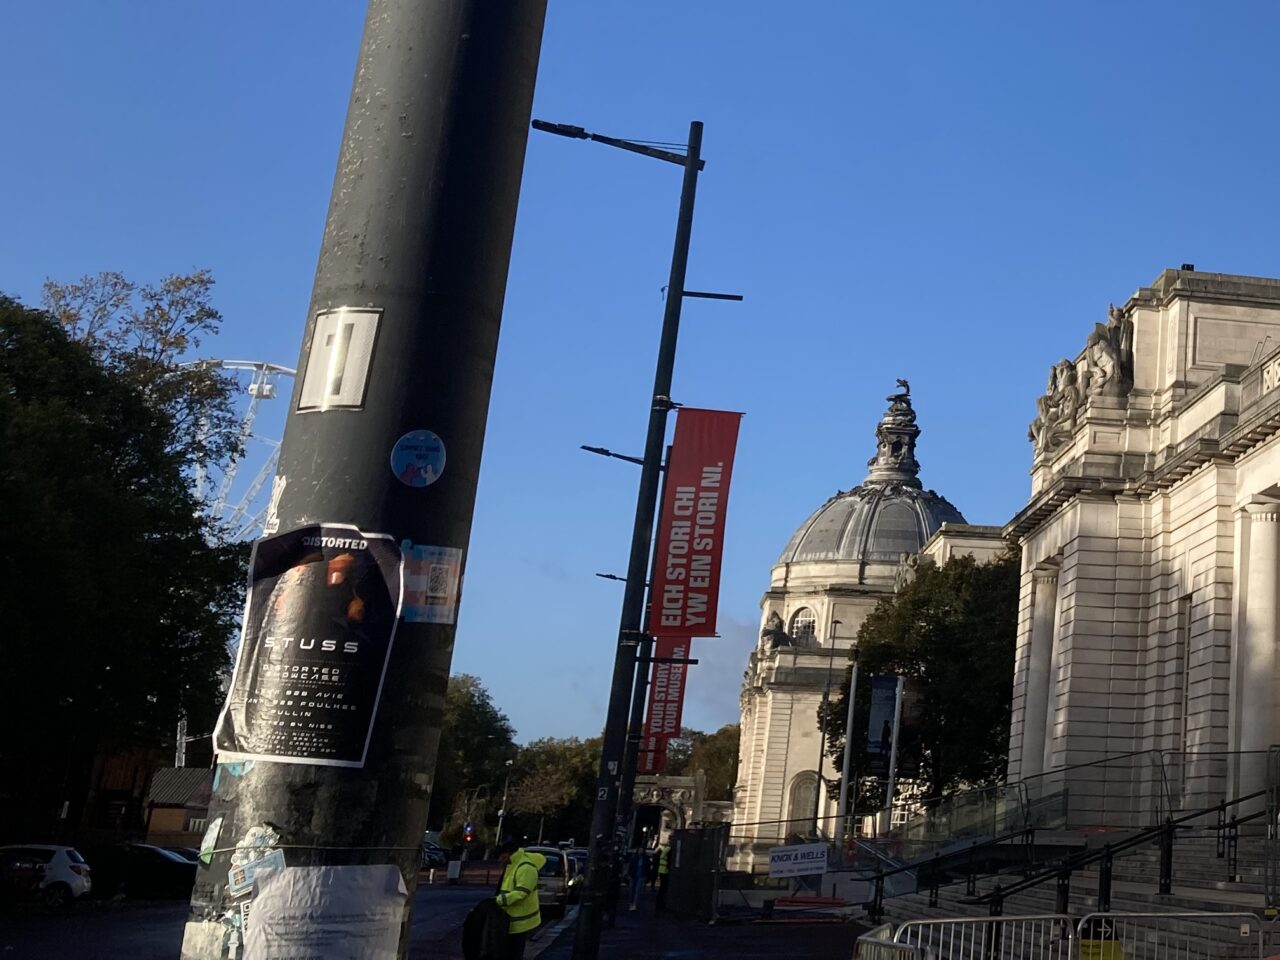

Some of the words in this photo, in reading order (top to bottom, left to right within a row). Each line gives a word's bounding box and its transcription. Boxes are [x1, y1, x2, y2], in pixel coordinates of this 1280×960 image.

[701, 461, 724, 487] NI.
[673, 486, 696, 516] CHI
[693, 492, 719, 551] STORI
[302, 537, 368, 550] DISTORTED
[666, 520, 691, 580] STORI
[689, 555, 712, 588] EIN
[660, 584, 684, 627] EICH
[685, 593, 708, 627] YW
[264, 636, 359, 653] STUSS
[650, 702, 665, 733] YOUR
[663, 703, 678, 734] YOUR
[600, 788, 607, 799] 2
[771, 853, 792, 862] KNOX
[800, 851, 825, 860] WELLS
